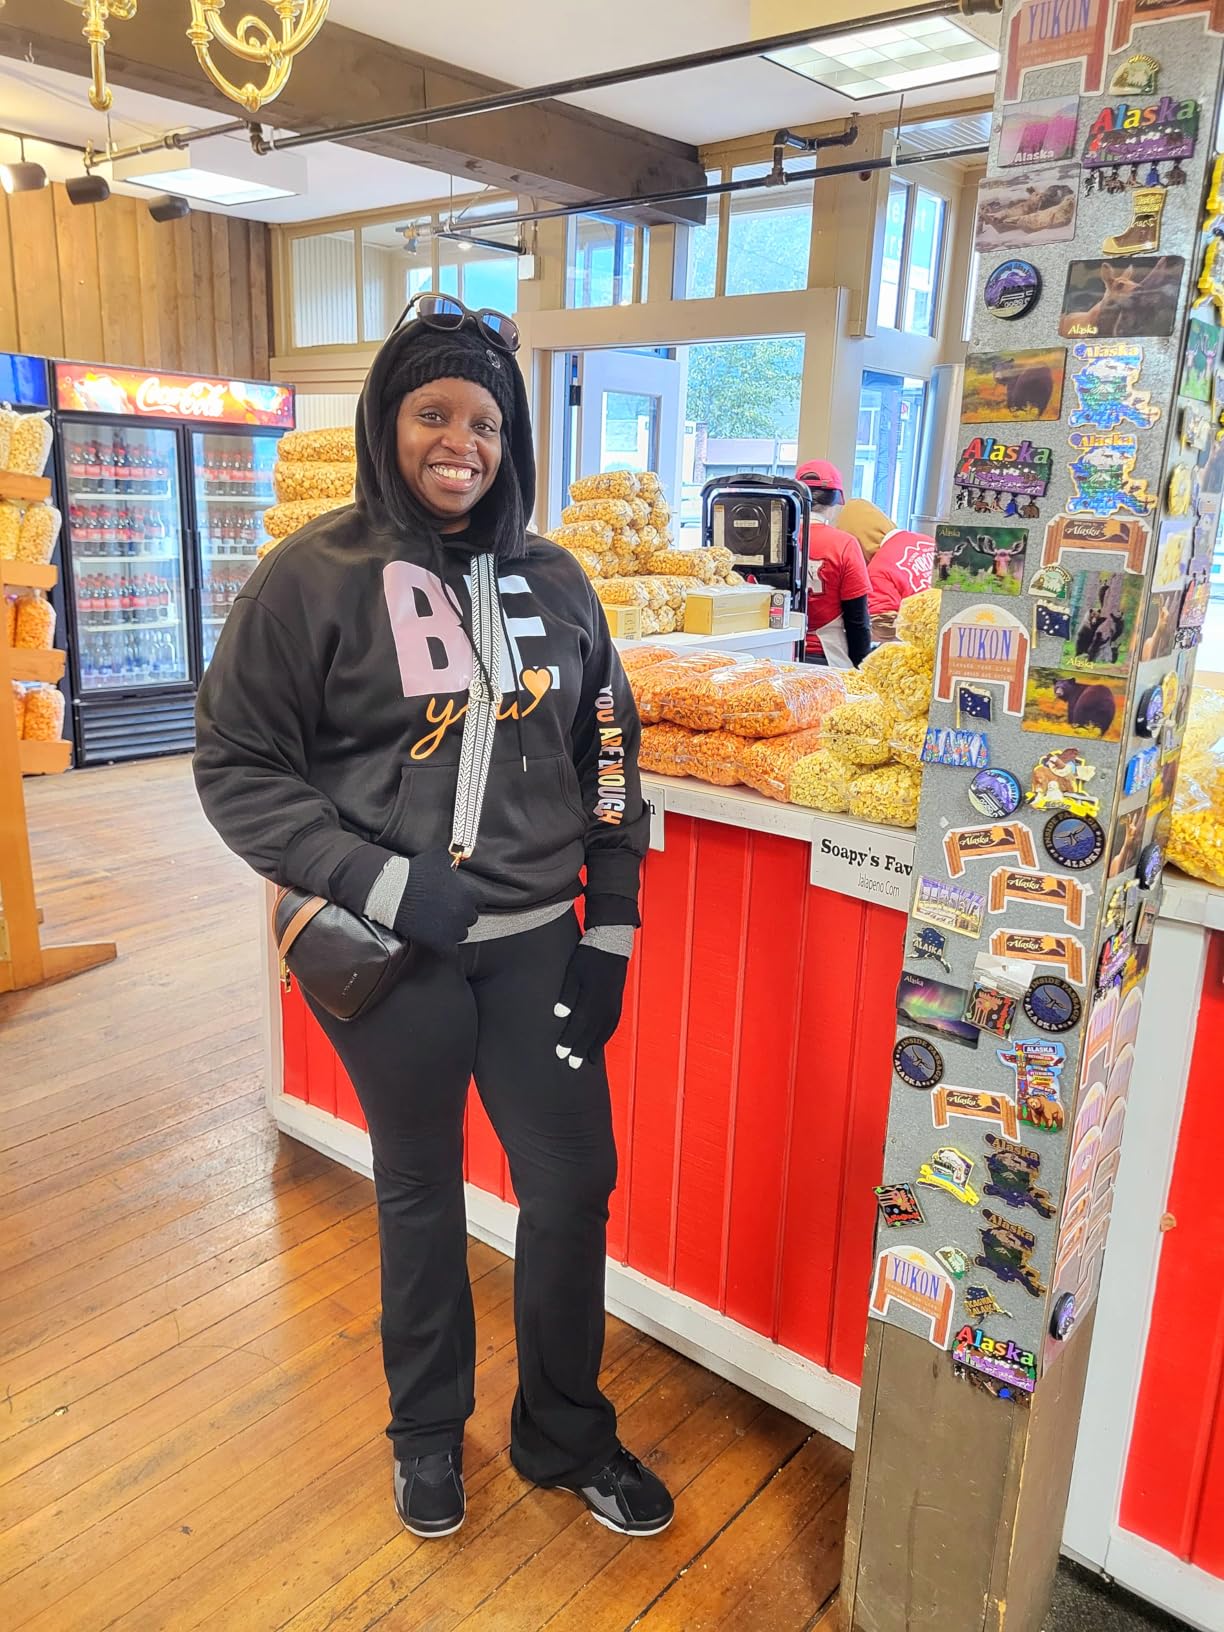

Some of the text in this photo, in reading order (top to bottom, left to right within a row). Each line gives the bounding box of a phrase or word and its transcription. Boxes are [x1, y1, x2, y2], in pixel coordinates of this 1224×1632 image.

[1027, 0, 1091, 44] YUKON
[1090, 96, 1196, 134] Alaska
[1014, 149, 1055, 163] Alaska
[1068, 325, 1098, 335] Alaska
[1086, 343, 1138, 357] Alaska
[1081, 433, 1133, 447] Alaska
[963, 437, 1050, 464] Alaska
[939, 527, 961, 538] Alaska
[1065, 525, 1100, 537] Alaska
[957, 627, 1013, 661] YUKON
[1066, 657, 1095, 670] Alaska
[594, 684, 615, 723] YOU
[410, 690, 542, 760] yu
[598, 727, 625, 760] ARE
[960, 836, 989, 846] Alaska
[821, 838, 880, 867] Soapy's
[1063, 847, 1102, 868] ALASKA
[885, 880, 900, 897] Corn
[1008, 878, 1040, 890] Alaska
[913, 938, 942, 956] ALASKA
[1007, 939, 1039, 950] Alaska
[904, 975, 924, 987] Alaska
[1030, 977, 1061, 990] INSIDE
[1024, 1003, 1058, 1031] ALASKA
[900, 1037, 928, 1048] INSIDE
[894, 1059, 922, 1087] ALASKA
[947, 1095, 976, 1106] Alaska
[993, 1138, 1039, 1161] Alaska
[990, 1214, 1035, 1241] Alaska
[893, 1256, 940, 1301] YUKON
[956, 1325, 1034, 1366] Alaska
